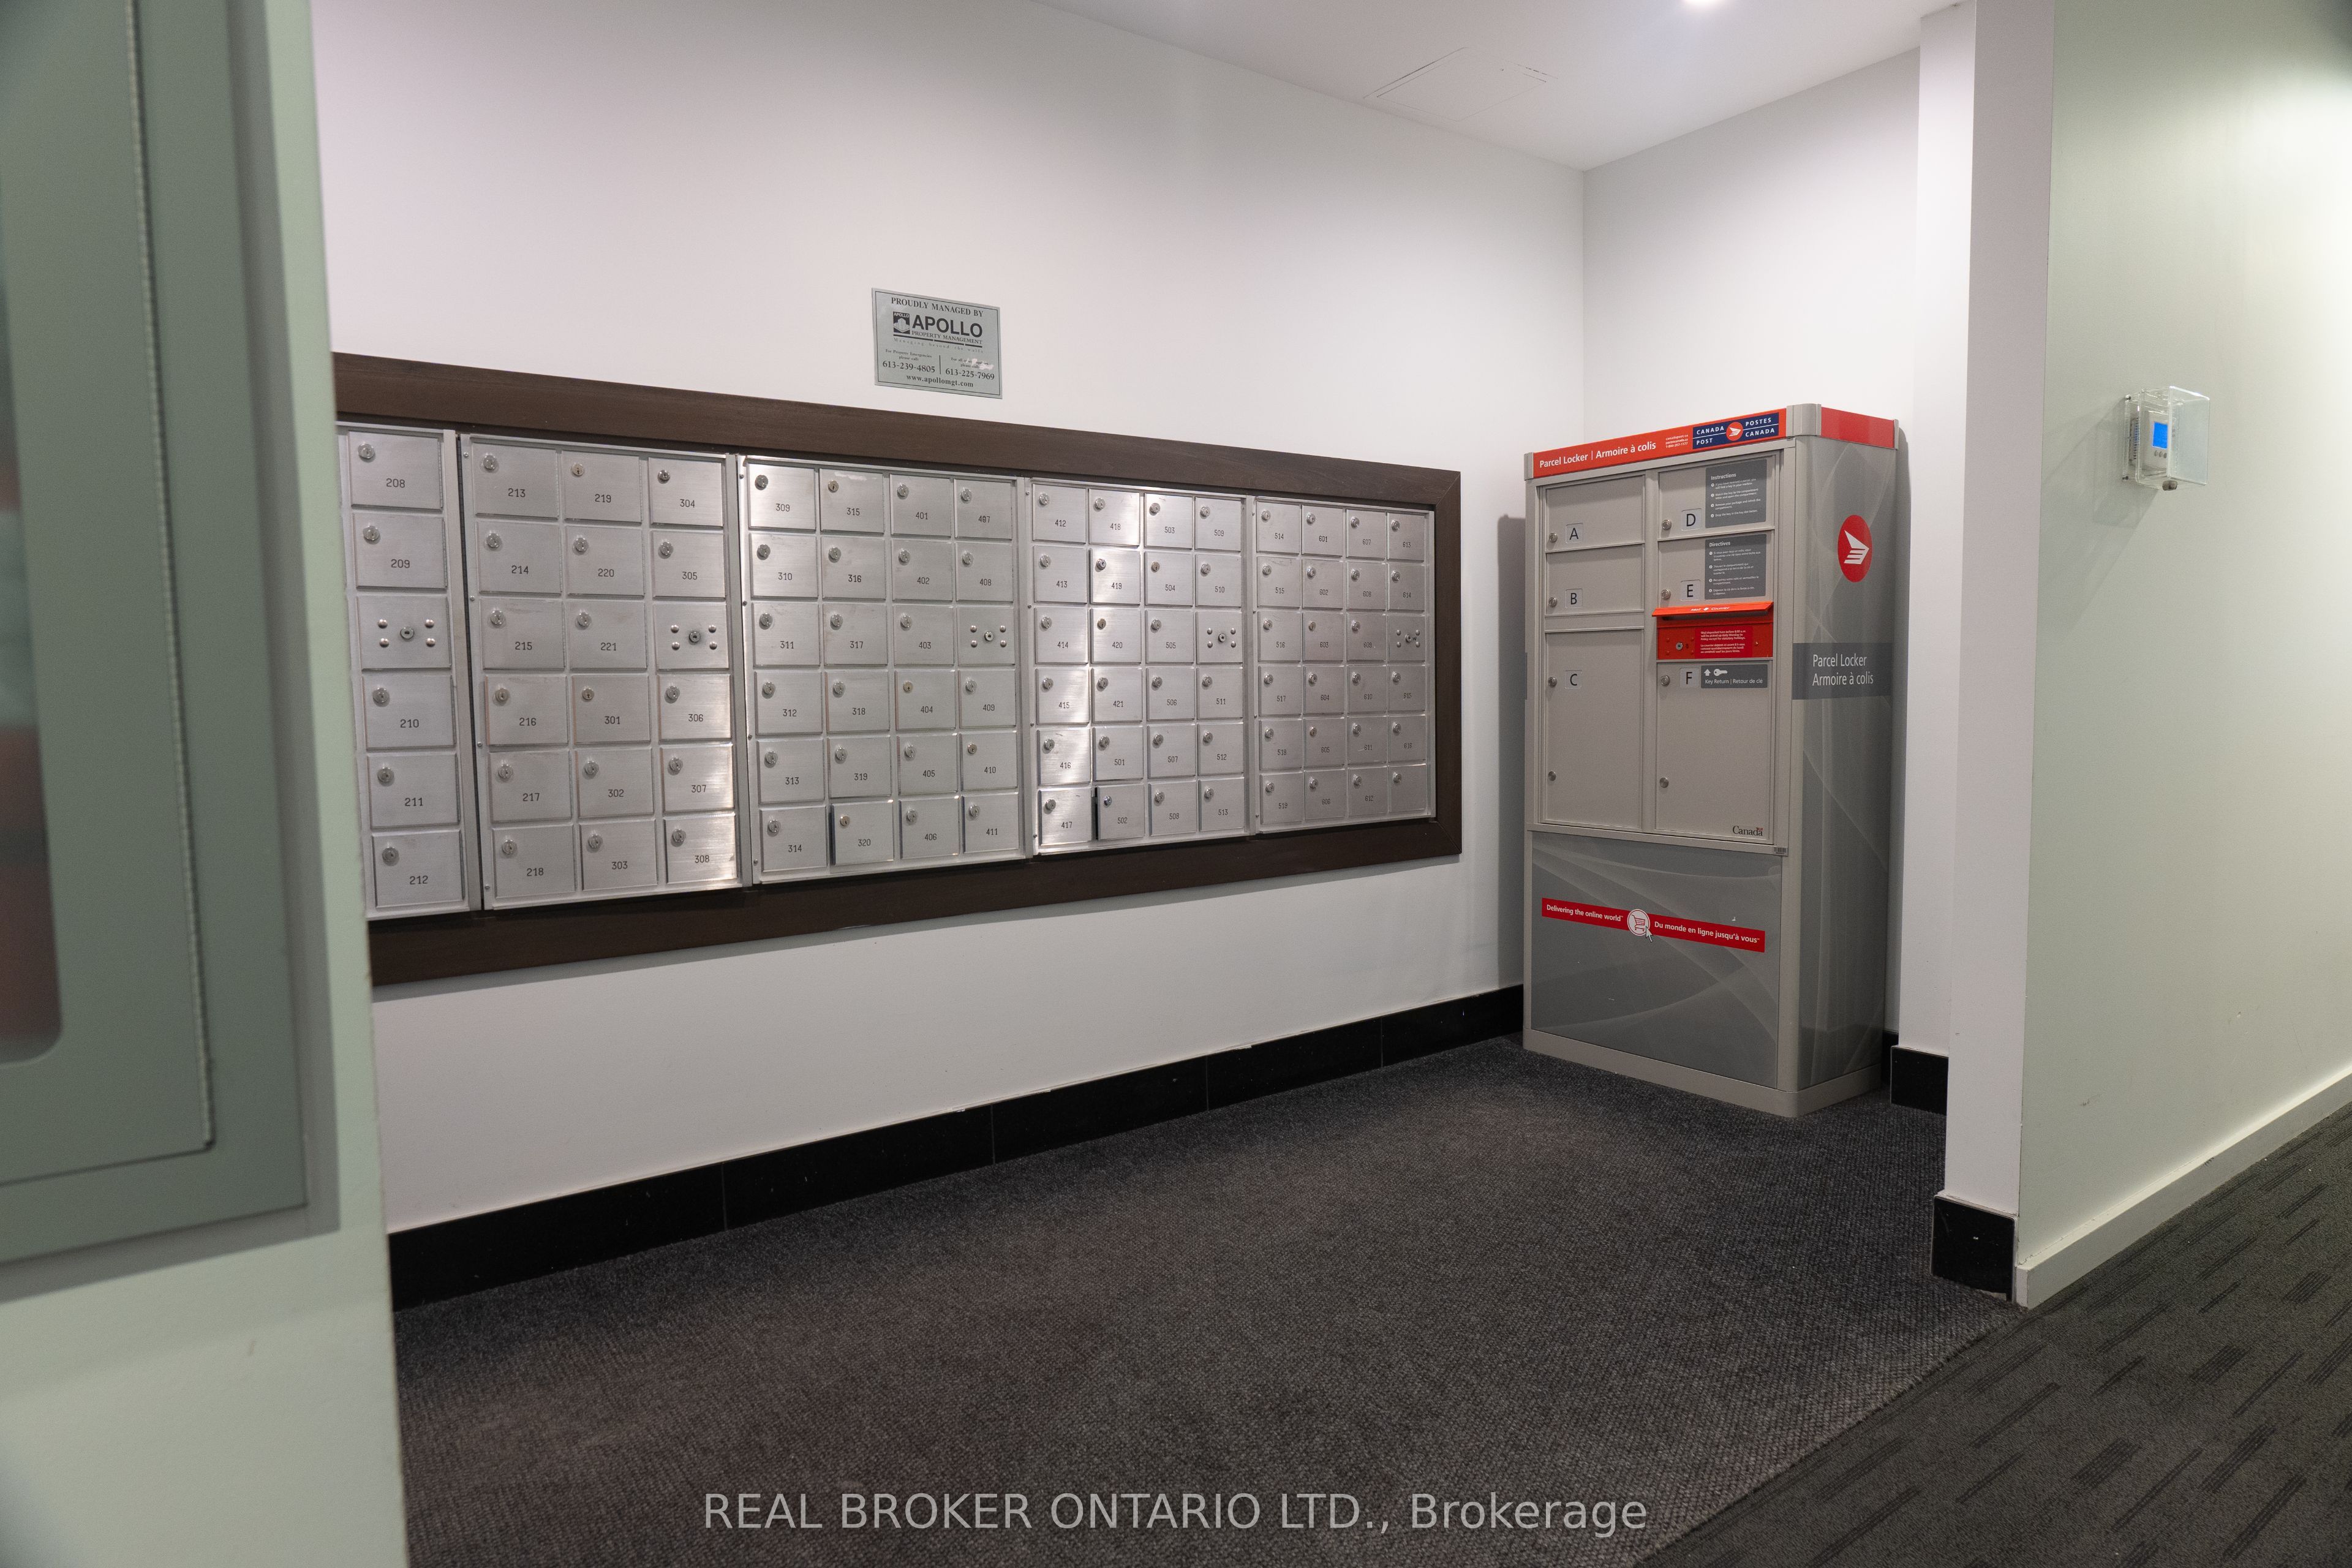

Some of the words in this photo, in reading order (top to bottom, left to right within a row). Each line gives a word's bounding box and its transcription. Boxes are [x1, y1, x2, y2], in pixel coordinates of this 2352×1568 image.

[891, 297, 929, 309] PROUDLY
[932, 303, 970, 315] MANAGED
[912, 315, 982, 337] APOLLO
[943, 334, 982, 344] MANAGEMENT
[883, 360, 935, 373] 613-239-4805
[946, 368, 995, 380] 613-225-7969
[907, 374, 973, 387] www.apollomgt.com
[1746, 418, 1771, 426] POSTES
[1697, 426, 1724, 435] CANADA
[1746, 428, 1775, 437] CANADA
[1540, 457, 1561, 468] Parcel
[1563, 453, 1588, 464] Locker
[1596, 447, 1628, 458] Armoire
[1630, 445, 1635, 453] à
[1638, 441, 1656, 452] colis
[386, 478, 405, 488] 208
[508, 488, 526, 498] 213
[595, 494, 611, 503] 219
[680, 499, 695, 508] 304
[775, 503, 790, 512] 309
[846, 507, 860, 516] 315
[915, 511, 928, 520] 401
[1686, 513, 1696, 527] D
[1055, 519, 1066, 527] 412
[1569, 528, 1579, 540] A
[391, 559, 410, 569] 209
[511, 565, 529, 575] 214
[598, 568, 614, 578] 220
[682, 571, 698, 581] 305
[778, 572, 793, 581] 310
[848, 574, 862, 583] 316
[917, 576, 930, 585] 402
[1687, 584, 1694, 597] E
[1570, 593, 1577, 605] B
[514, 641, 533, 650] 215
[600, 642, 617, 651] 221
[780, 641, 794, 649] 311
[1813, 653, 1838, 667] Parcel
[1841, 653, 1867, 666] Locker
[1570, 674, 1578, 686] C
[1686, 672, 1692, 684] F
[1812, 672, 1847, 686] Armoire
[1849, 671, 1853, 685] à
[1856, 671, 1874, 685] colis
[688, 714, 704, 722] 306
[782, 709, 797, 717] 312
[400, 718, 420, 728] 210
[519, 717, 537, 726] 216
[605, 715, 620, 725] 301
[785, 777, 799, 785] 313
[608, 789, 624, 797] 302
[691, 784, 706, 793] 307
[404, 797, 423, 807] 211
[522, 793, 540, 802] 217
[1732, 826, 1763, 836] Canada
[858, 839, 871, 847] 320
[788, 844, 802, 853] 314
[695, 854, 710, 864] 308
[611, 861, 628, 870] 303
[526, 867, 544, 877] 218
[409, 875, 429, 885] 212
[1547, 904, 1574, 915] Delivering
[1698, 927, 1714, 937] ligne
